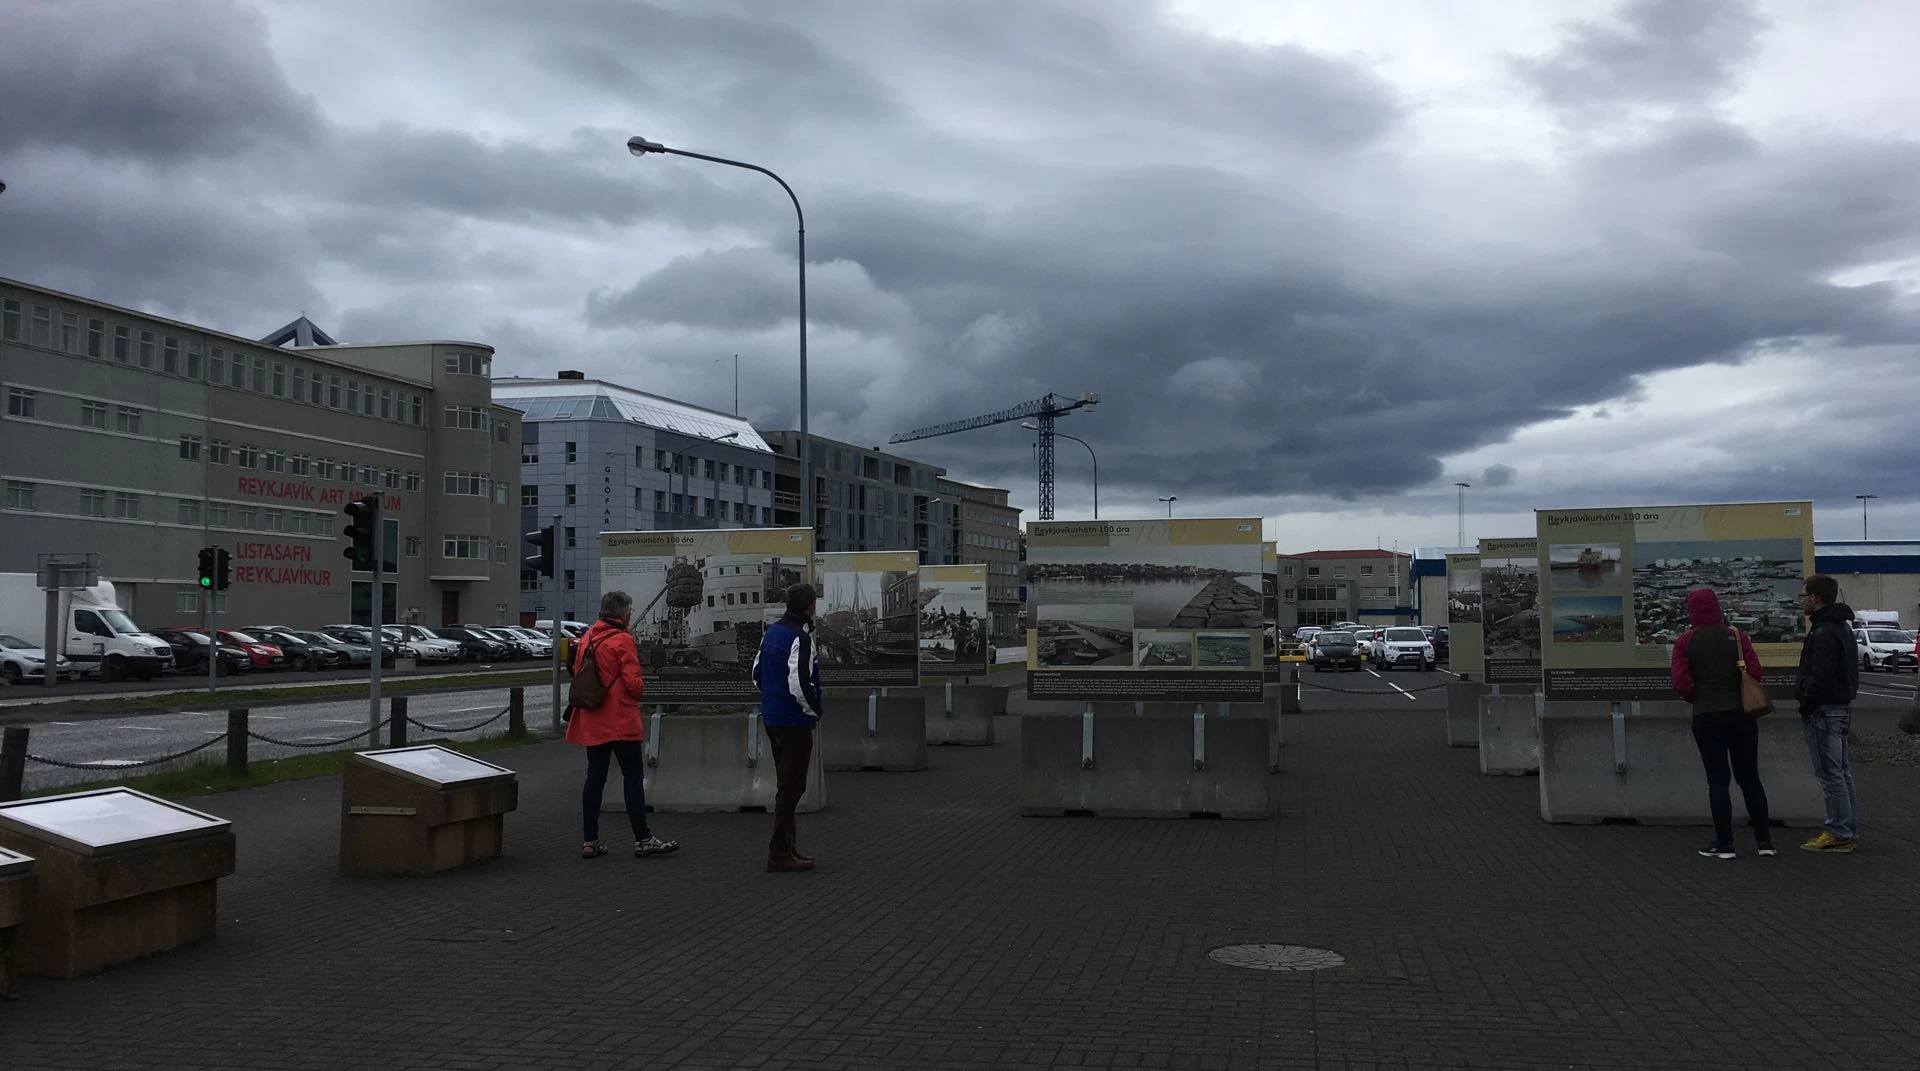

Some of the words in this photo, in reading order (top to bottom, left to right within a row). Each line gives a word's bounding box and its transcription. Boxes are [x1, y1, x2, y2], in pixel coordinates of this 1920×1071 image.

[238, 476, 315, 502] REYKJAVÍK
[319, 487, 345, 504] ART
[1623, 512, 1640, 521] 100
[1099, 525, 1114, 534] 100
[666, 536, 680, 544] 100
[236, 542, 312, 562] LISTASAFN
[236, 565, 331, 586] REYKJAVÍKUR
